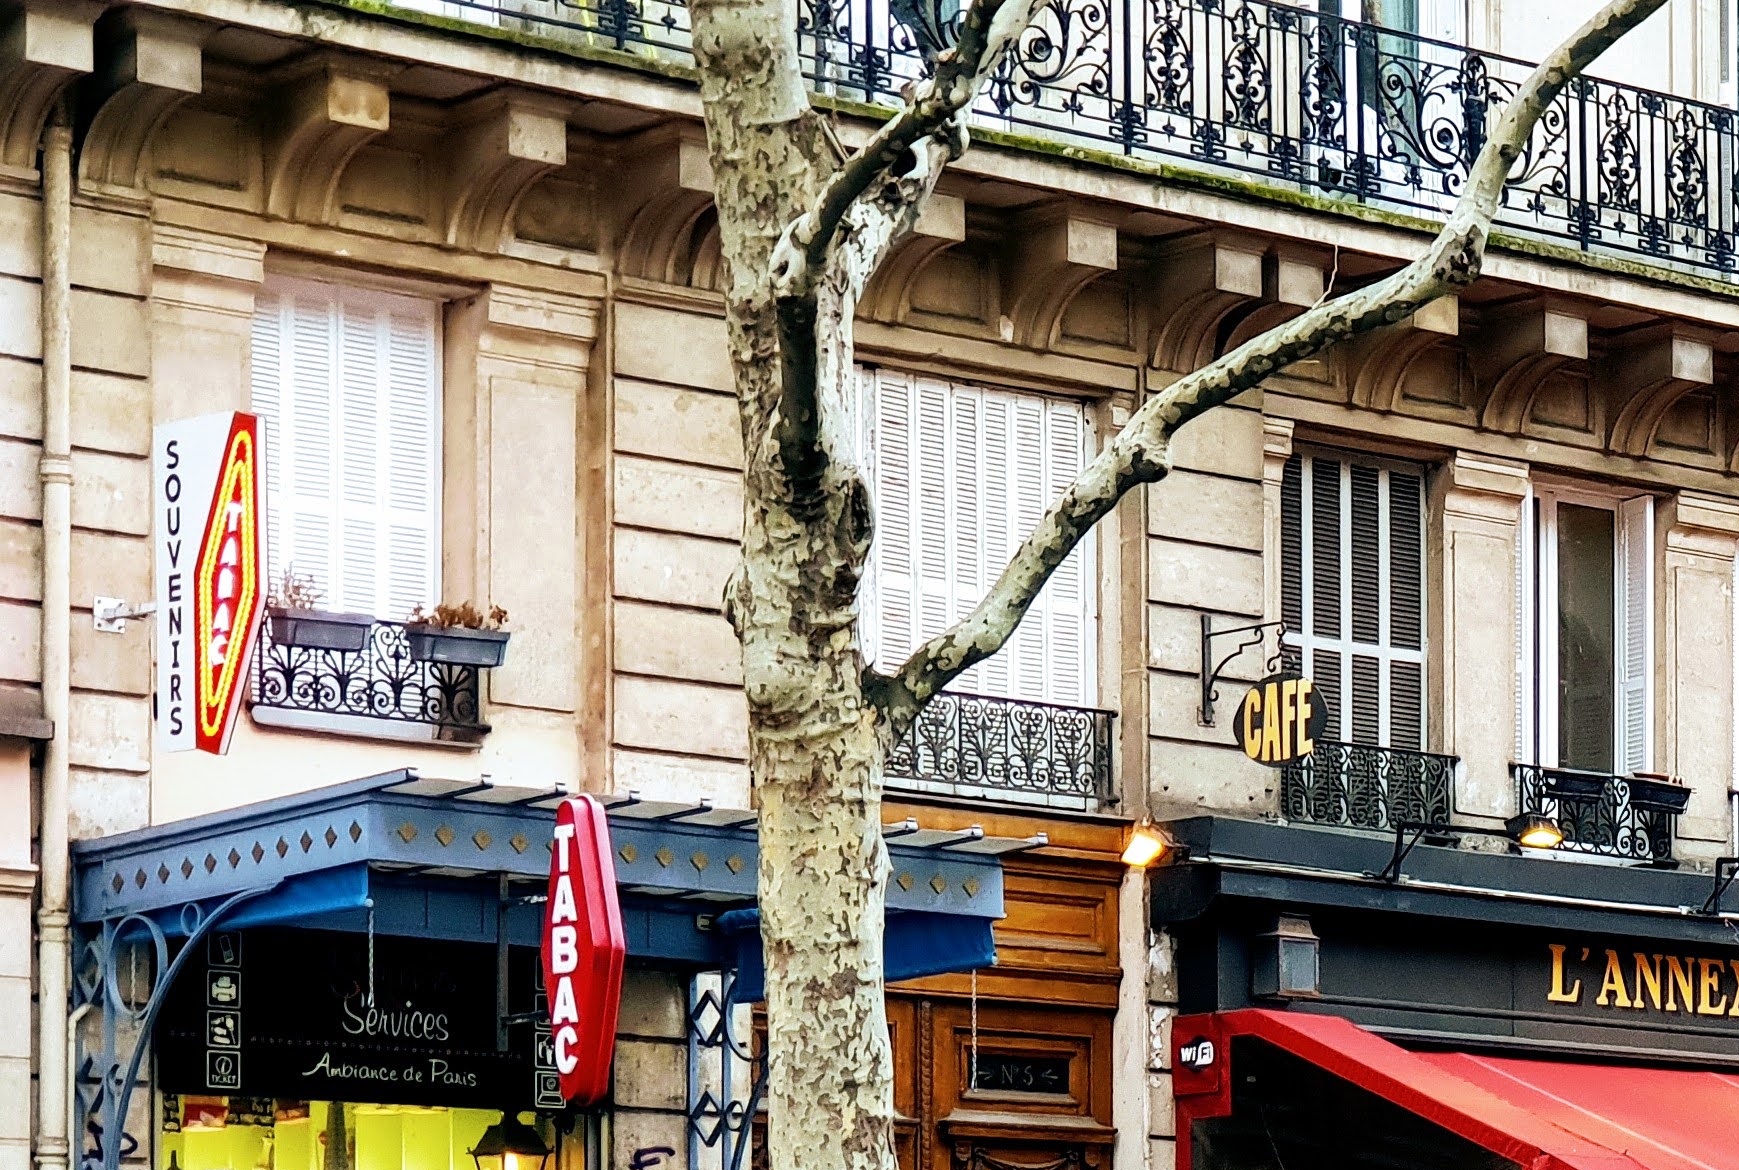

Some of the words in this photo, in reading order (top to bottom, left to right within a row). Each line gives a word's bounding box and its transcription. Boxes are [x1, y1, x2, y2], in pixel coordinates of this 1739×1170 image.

[165, 440, 183, 736] SOUVENIRS
[1243, 678, 1315, 764] CAFE
[551, 824, 579, 1075] TABAC
[342, 993, 449, 1041] Services
[302, 1052, 398, 1081] Ambiance
[403, 1069, 422, 1083] de
[428, 1058, 477, 1087] Paris
